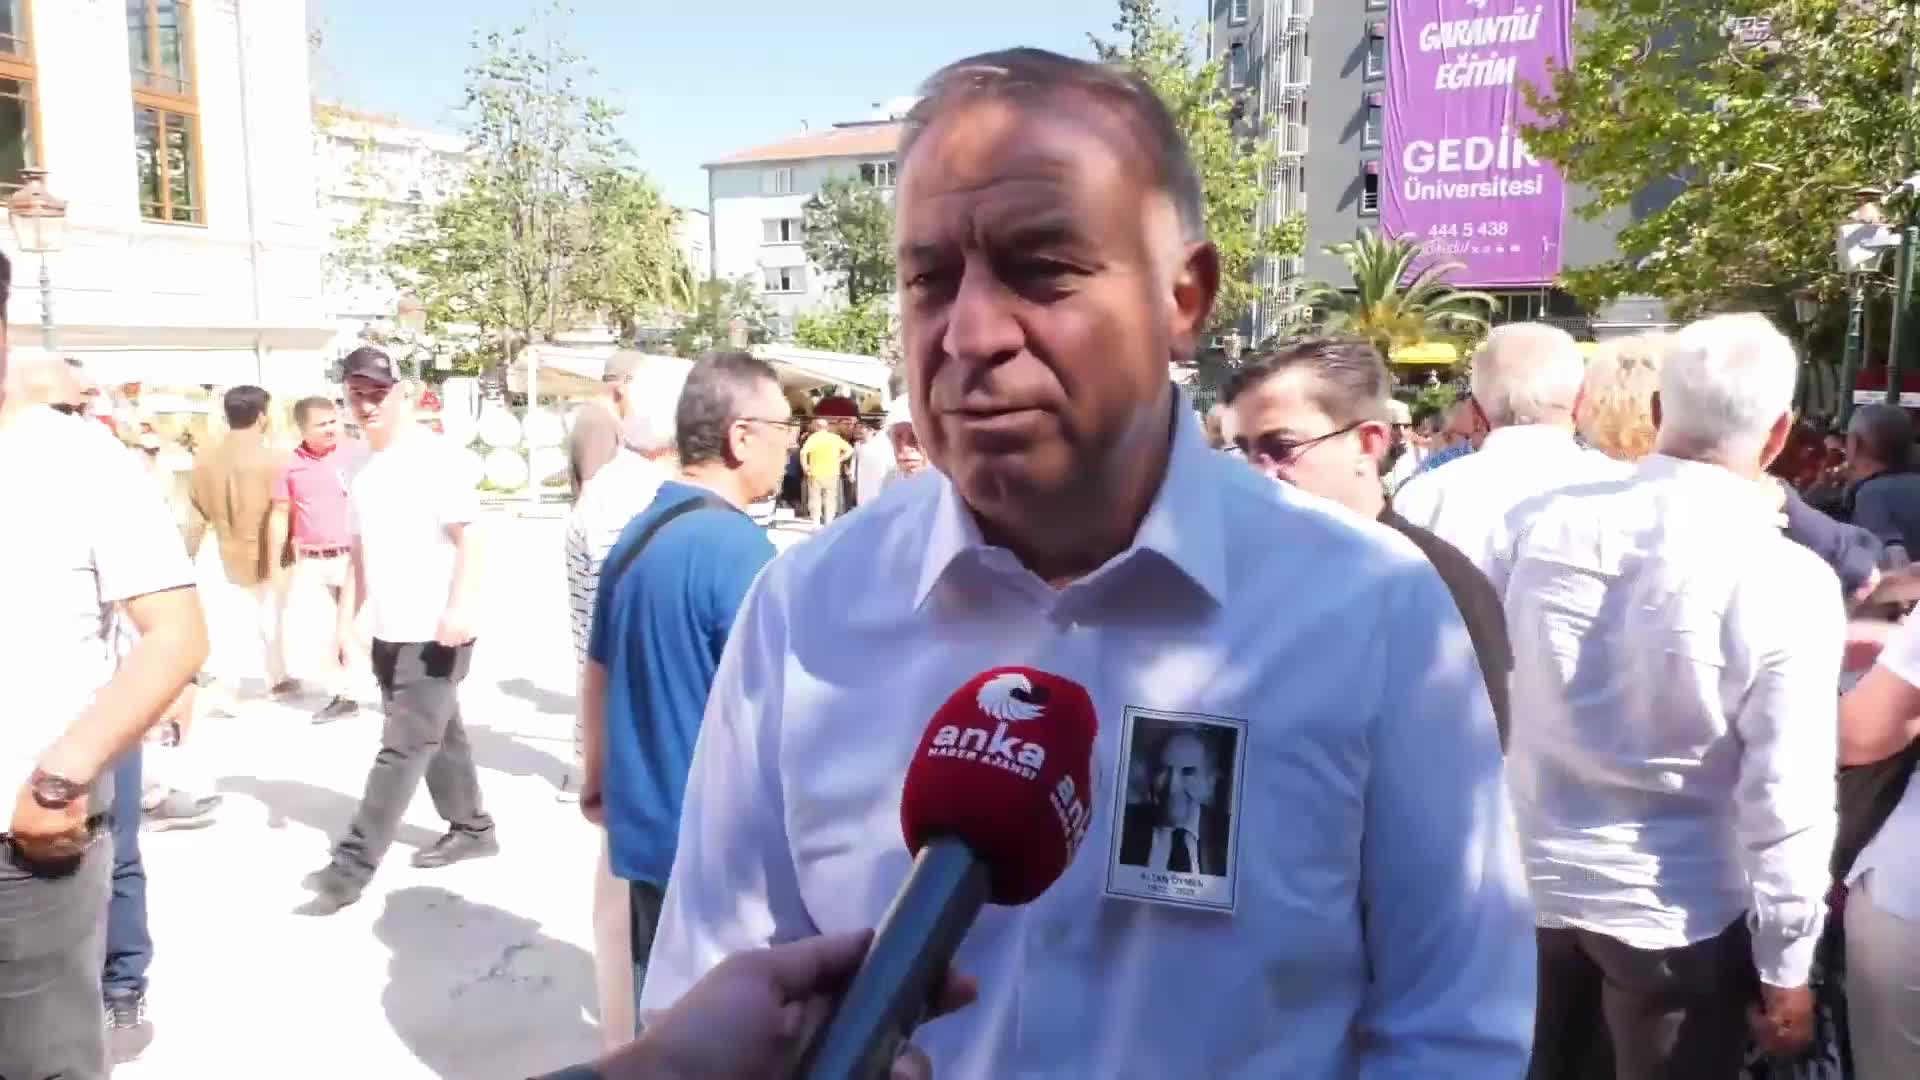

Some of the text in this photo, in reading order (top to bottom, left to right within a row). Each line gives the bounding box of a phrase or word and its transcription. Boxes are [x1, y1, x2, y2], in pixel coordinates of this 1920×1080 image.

[1419, 4, 1542, 52] GARANTİLİ
[1435, 51, 1517, 90] EĞİTİM
[1404, 173, 1543, 201] Üniversitesi
[1428, 220, 1509, 238] 444 5 438
[933, 720, 1045, 771] anka
